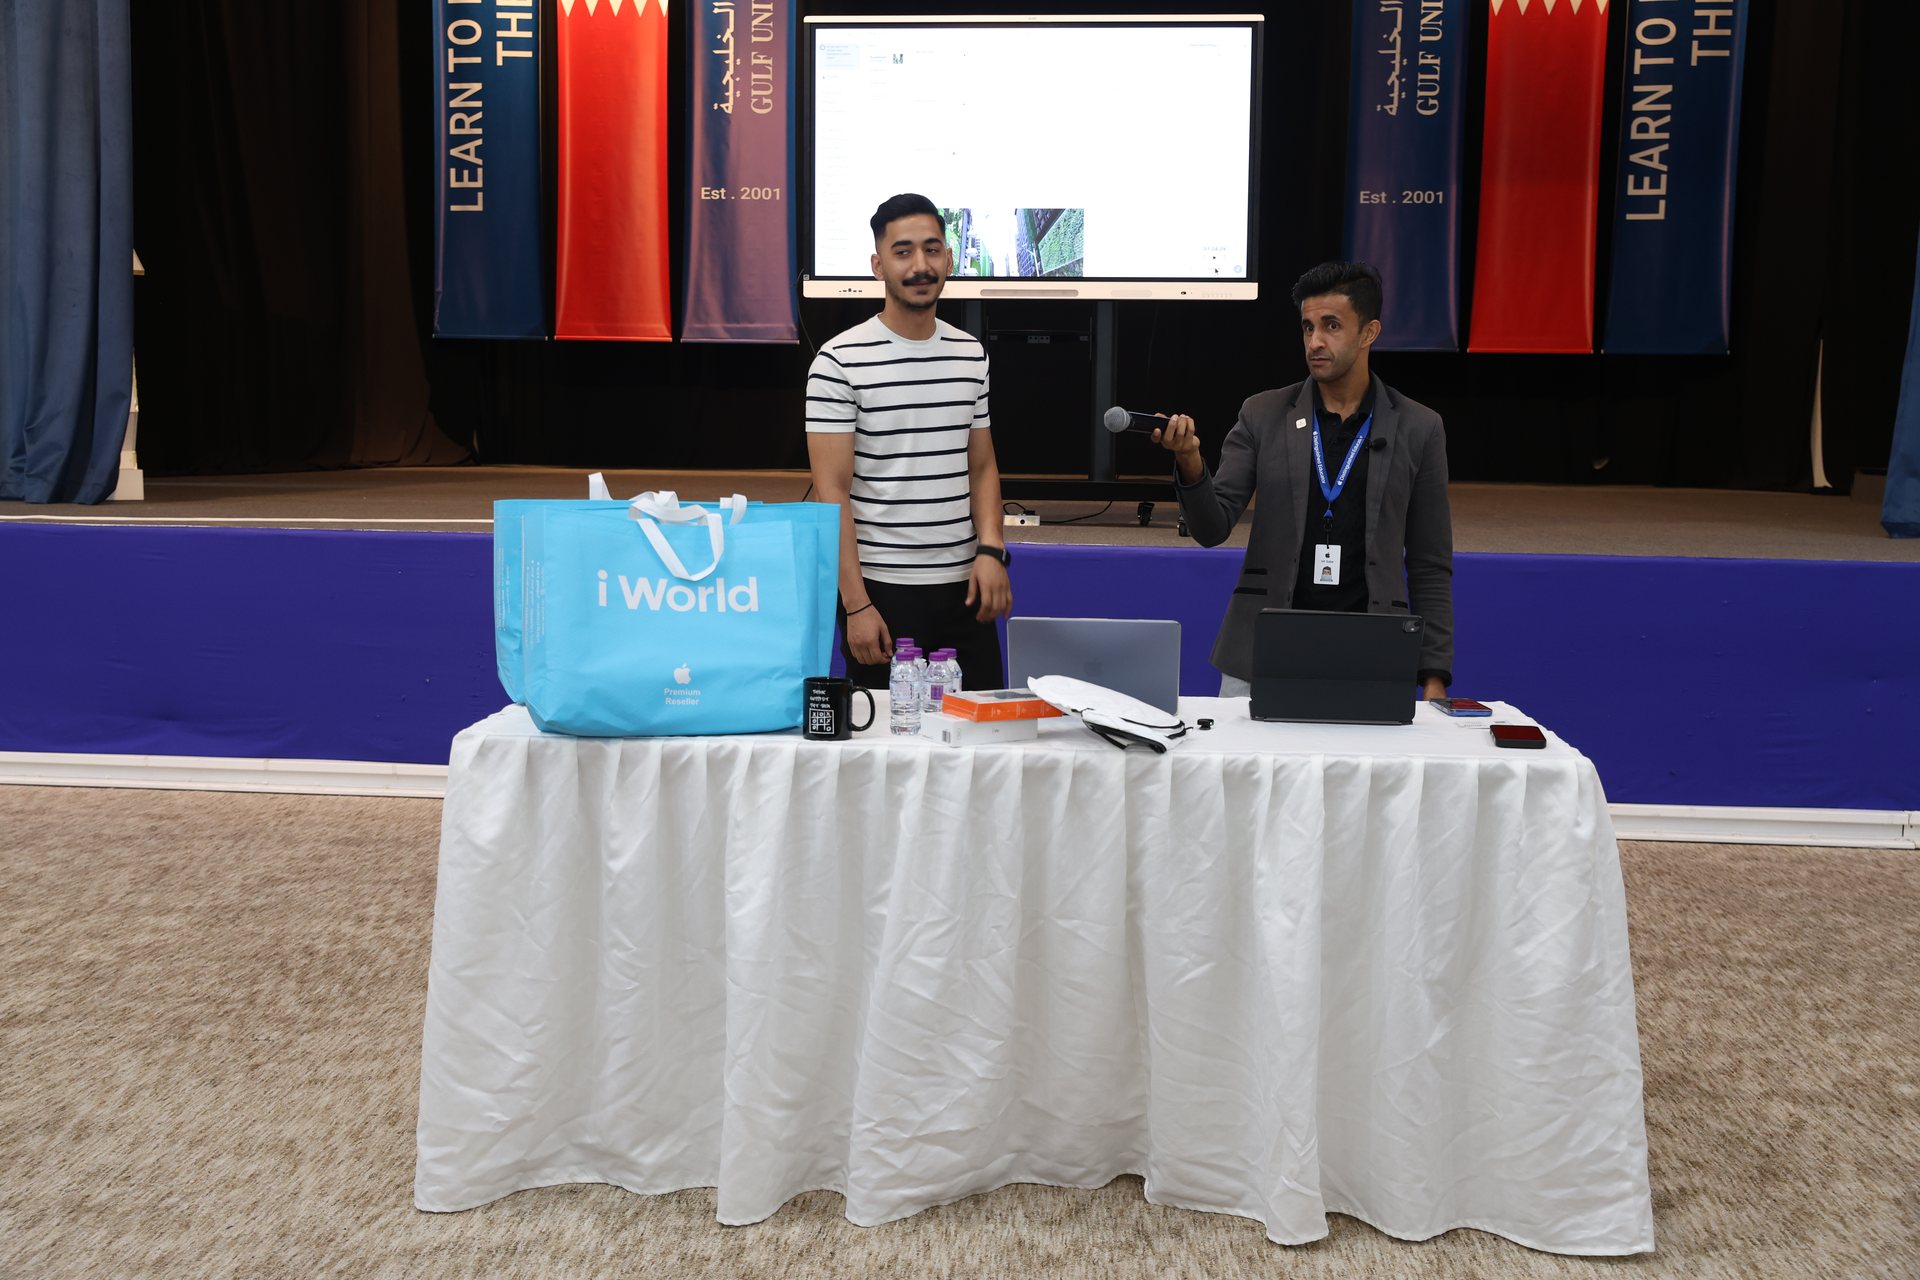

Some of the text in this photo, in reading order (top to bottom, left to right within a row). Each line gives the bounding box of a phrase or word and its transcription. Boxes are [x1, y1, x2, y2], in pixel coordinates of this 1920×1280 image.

[447, 19, 482, 73] TO
[712, 1, 741, 114] الخليجية
[1633, 17, 1677, 75] TO
[1690, 0, 1734, 66] TH
[750, 51, 773, 114] GULF
[1416, 51, 1441, 116] GULF
[449, 82, 483, 211] LEARN
[1625, 84, 1673, 221] LEARN
[740, 187, 781, 200] 2001
[1402, 190, 1444, 204] 2001
[618, 574, 760, 613] World
[664, 687, 702, 696] Premium
[665, 697, 701, 705] Reseller
